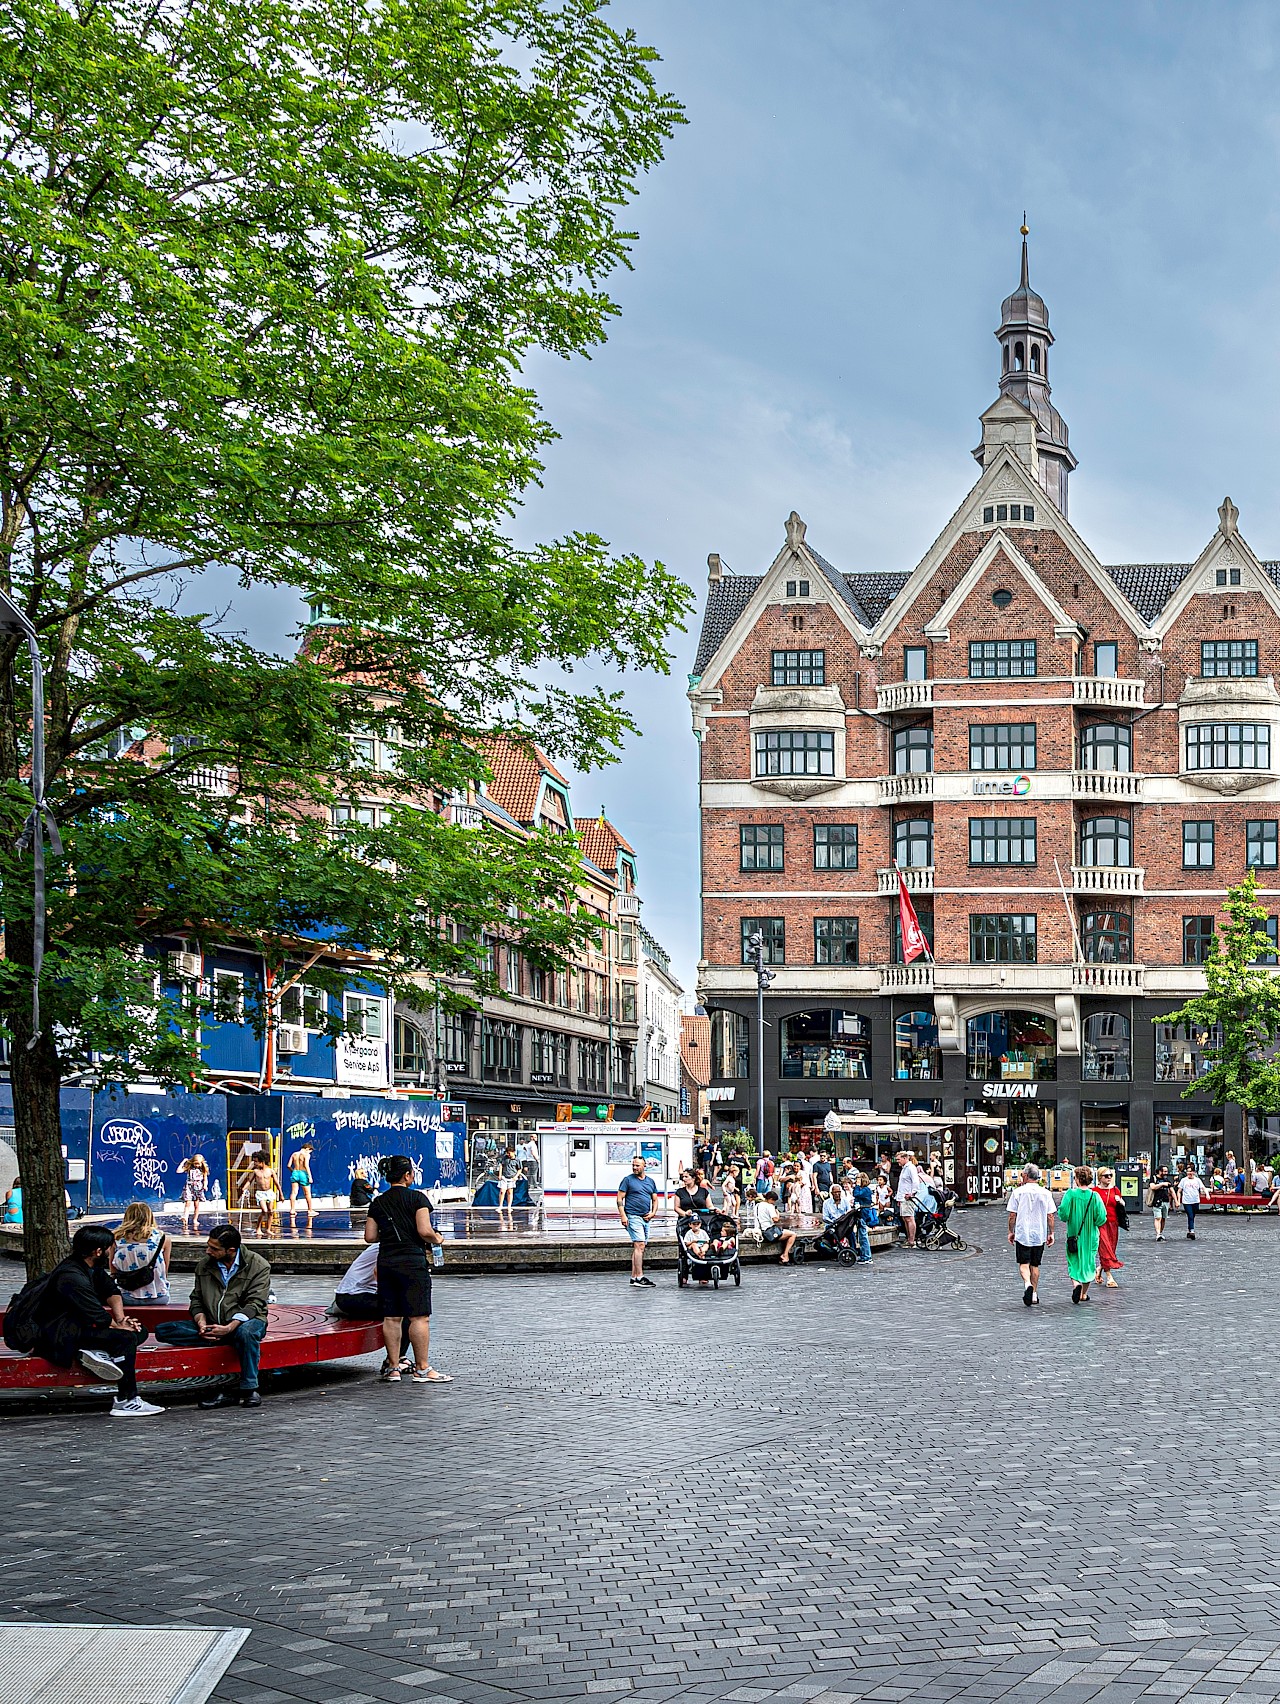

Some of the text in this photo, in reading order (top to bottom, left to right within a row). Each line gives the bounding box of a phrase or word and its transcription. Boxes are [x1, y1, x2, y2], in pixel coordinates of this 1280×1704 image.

[343, 1058, 367, 1070] Service
[531, 1074, 553, 1082] NEYE
[981, 1083, 1039, 1099] SILVAN
[982, 1165, 1000, 1173] WE DO
